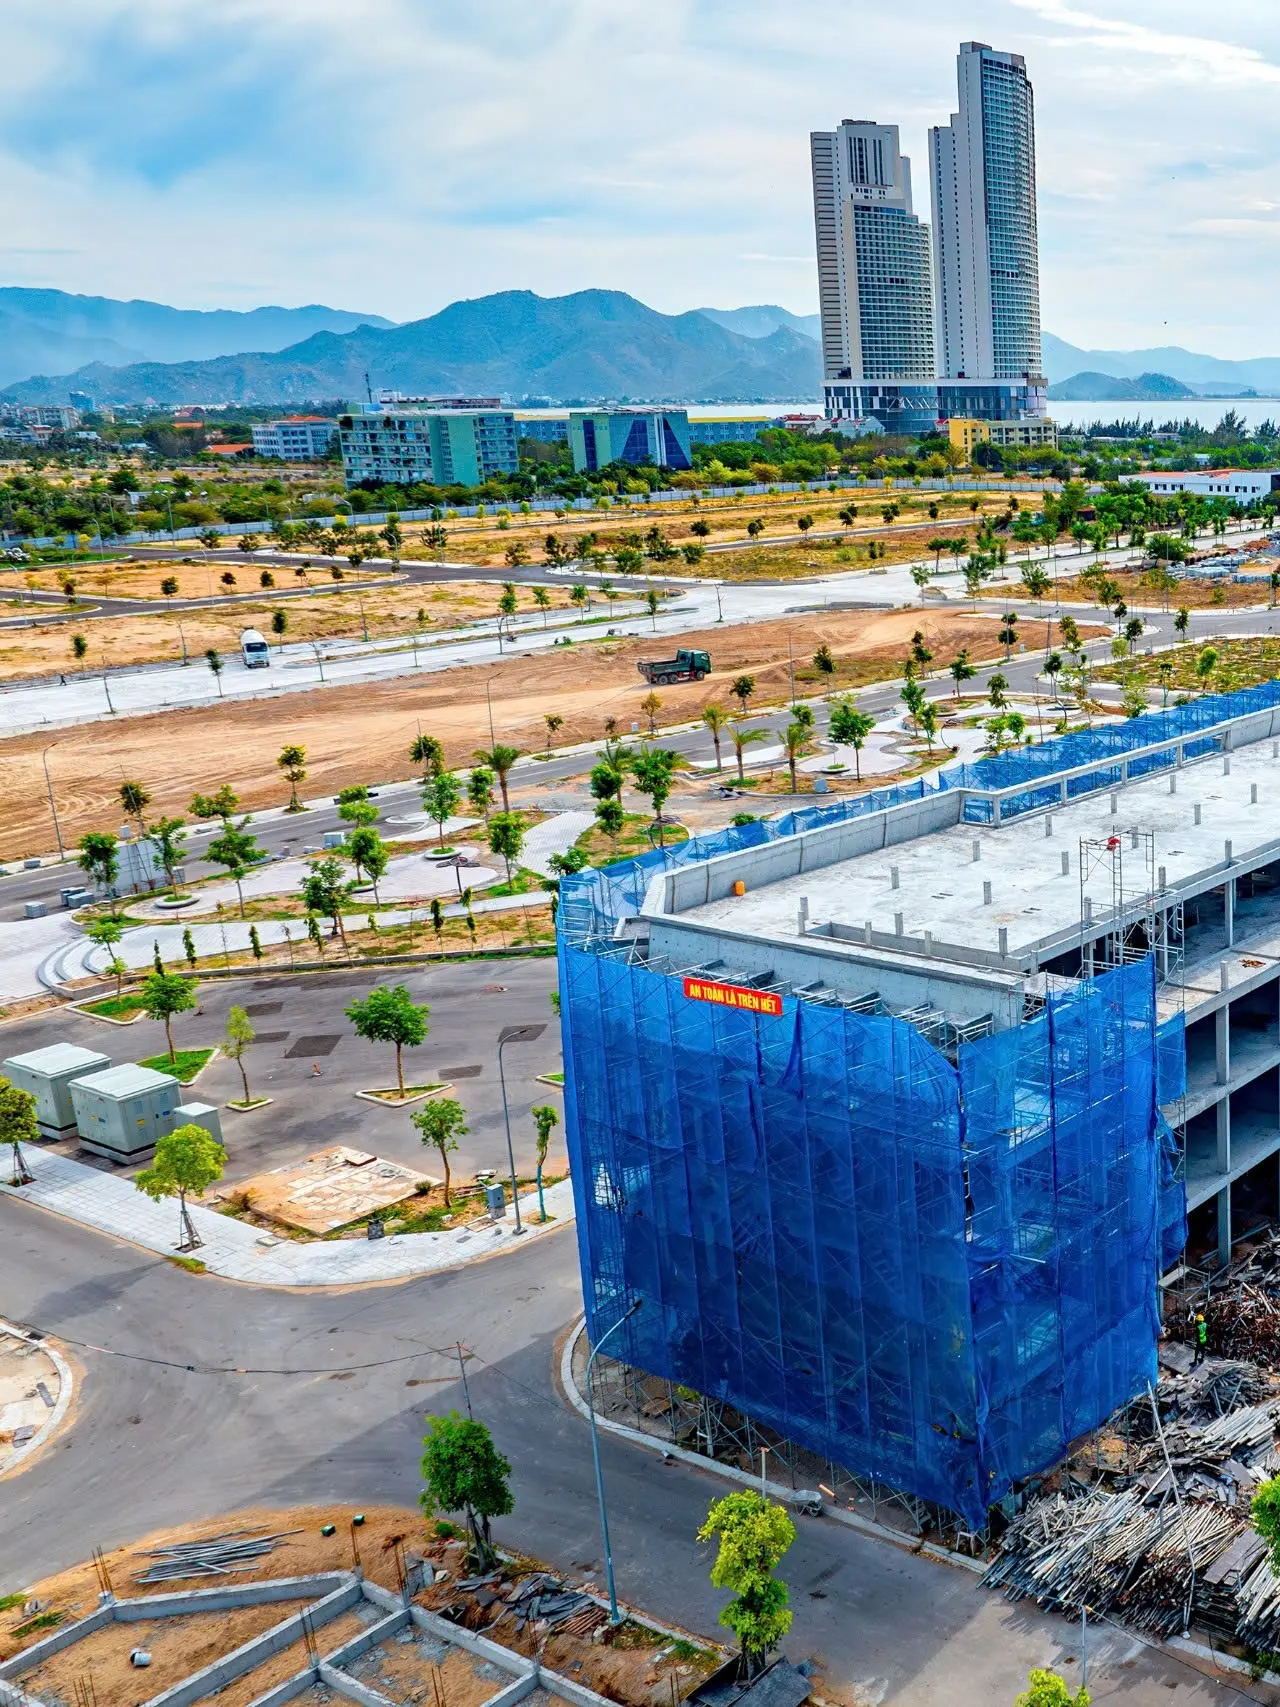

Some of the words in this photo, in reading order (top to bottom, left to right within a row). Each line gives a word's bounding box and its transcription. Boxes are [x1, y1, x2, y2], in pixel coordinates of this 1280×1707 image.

[690, 984, 702, 998] AN
[702, 986, 725, 1002] TOÀN
[725, 989, 736, 1005] LÀ
[737, 992, 759, 1009] TRÊN
